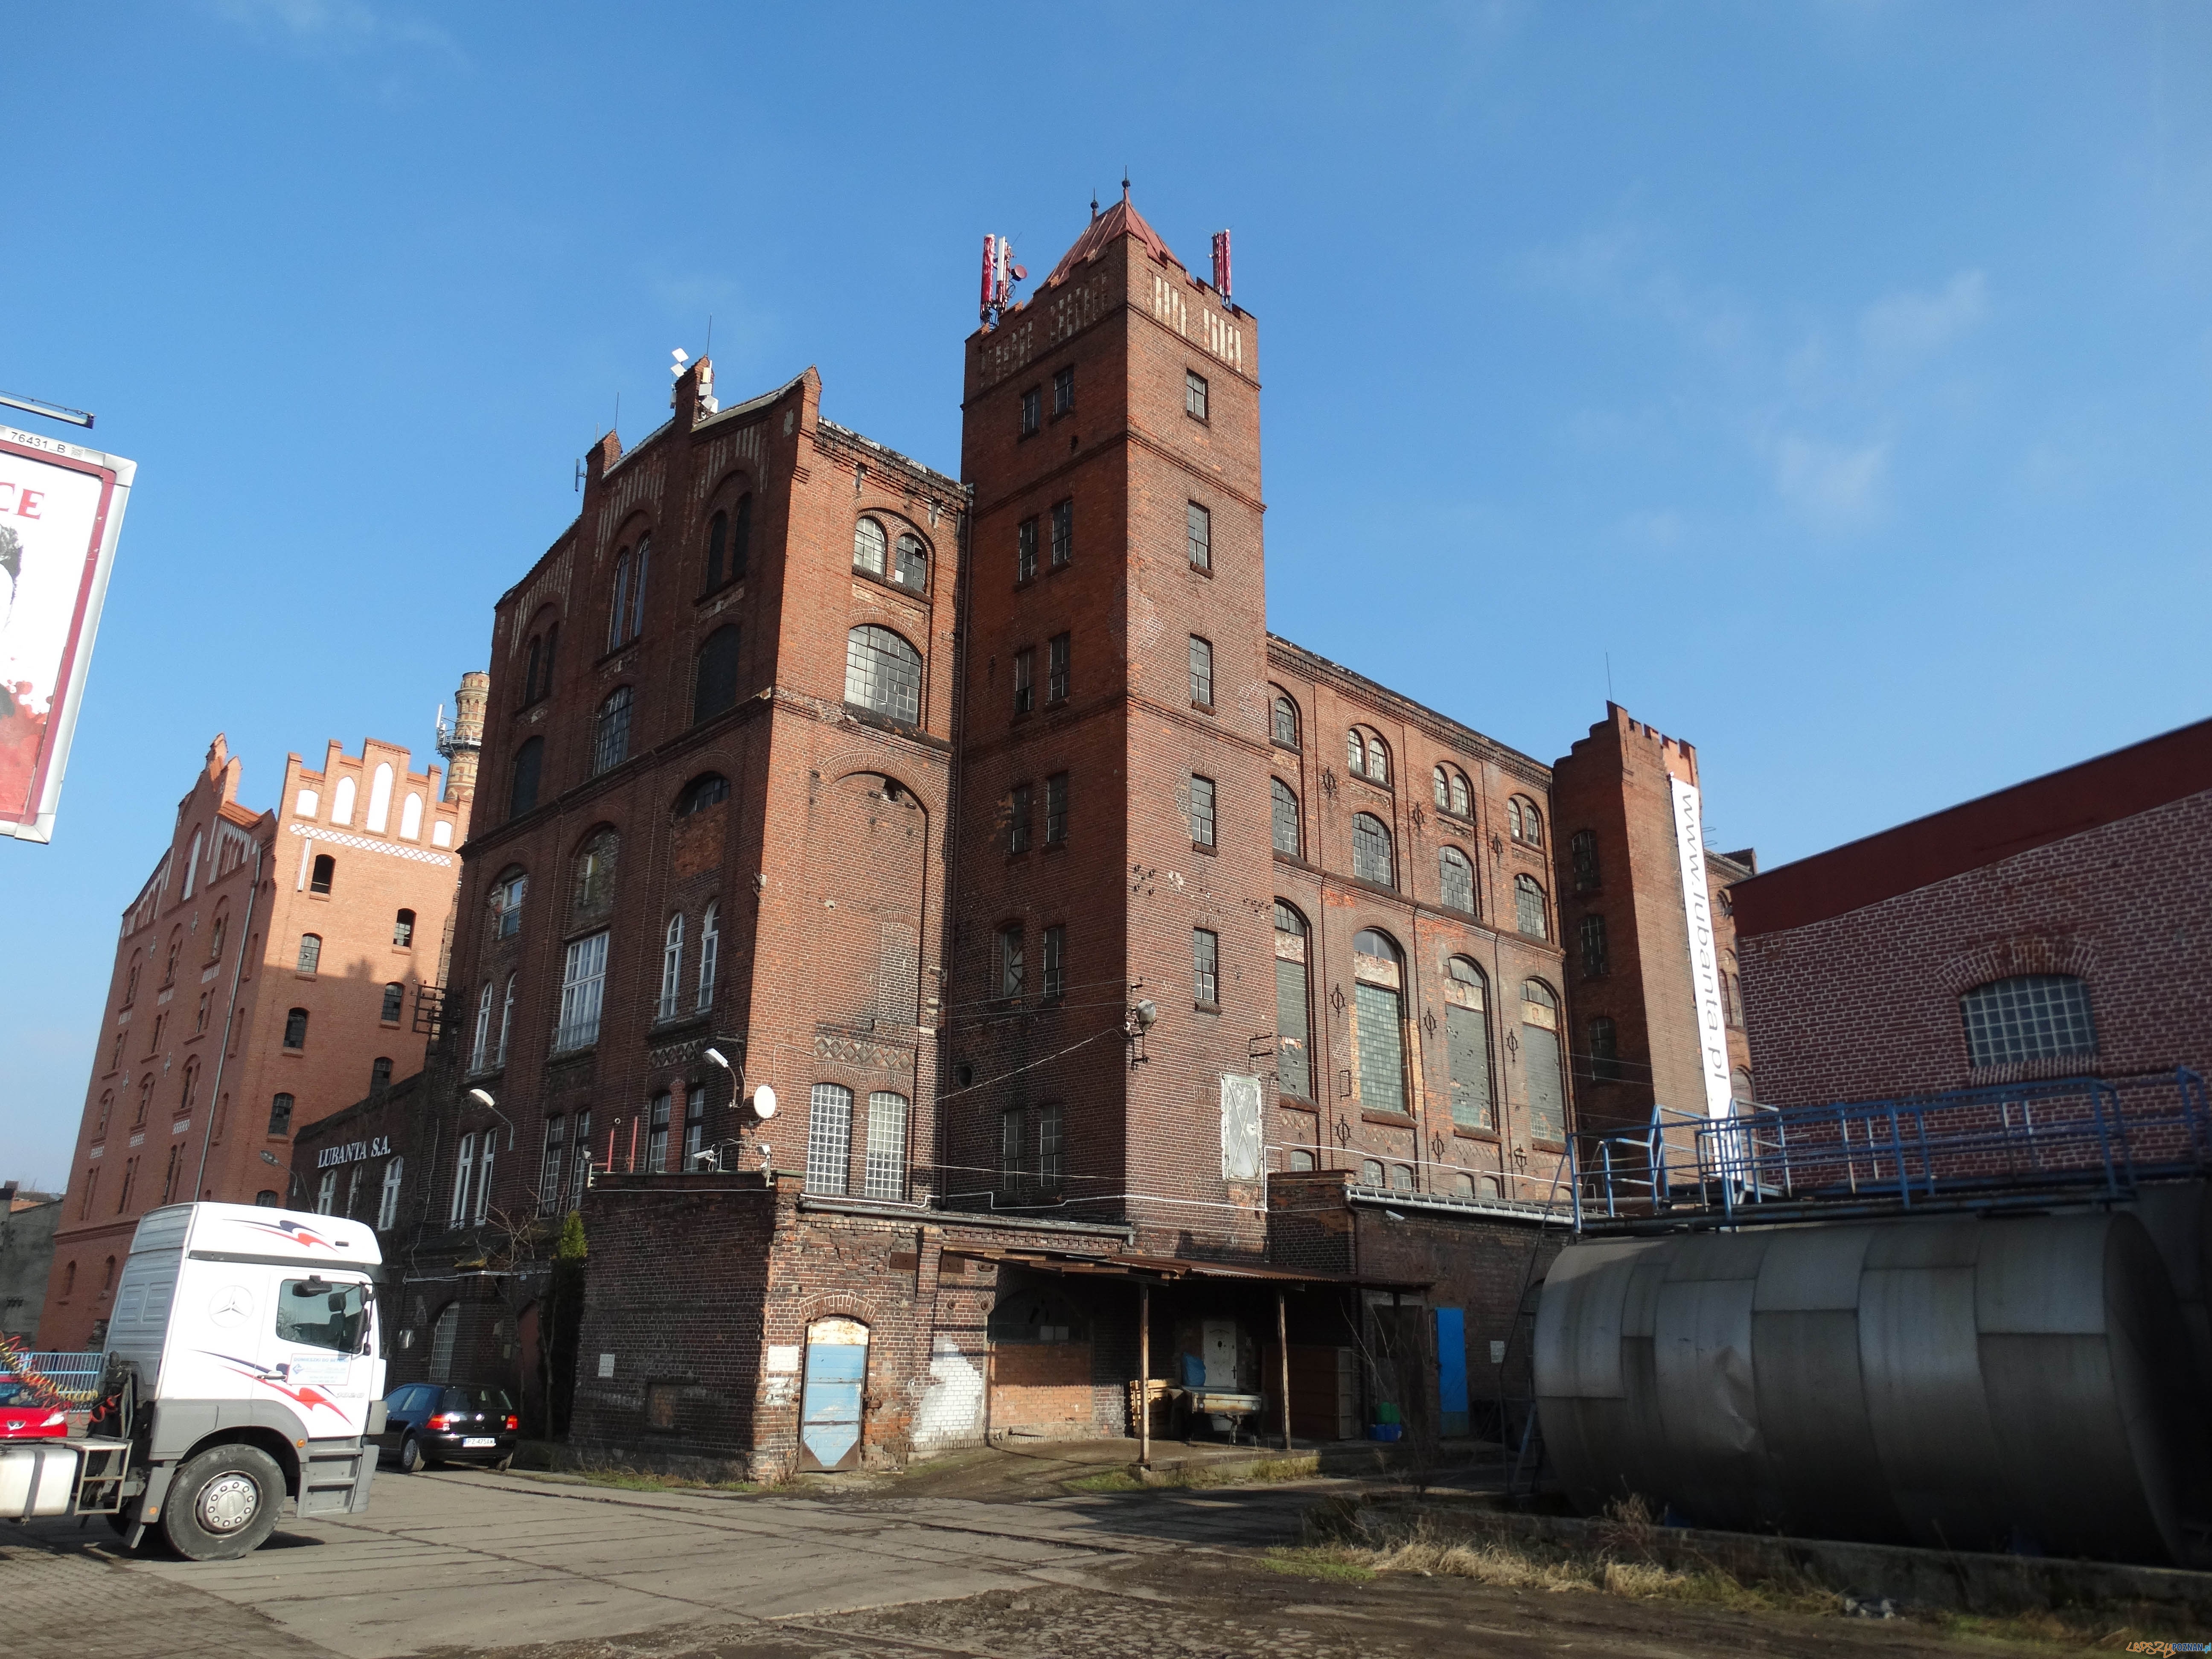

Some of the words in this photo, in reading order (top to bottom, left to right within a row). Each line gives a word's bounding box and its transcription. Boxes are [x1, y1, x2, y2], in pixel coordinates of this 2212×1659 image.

[1682, 794, 1726, 1080] www.lubanta.pl
[317, 1141, 367, 1168] LUBANTA
[370, 1135, 391, 1157] S.A.
